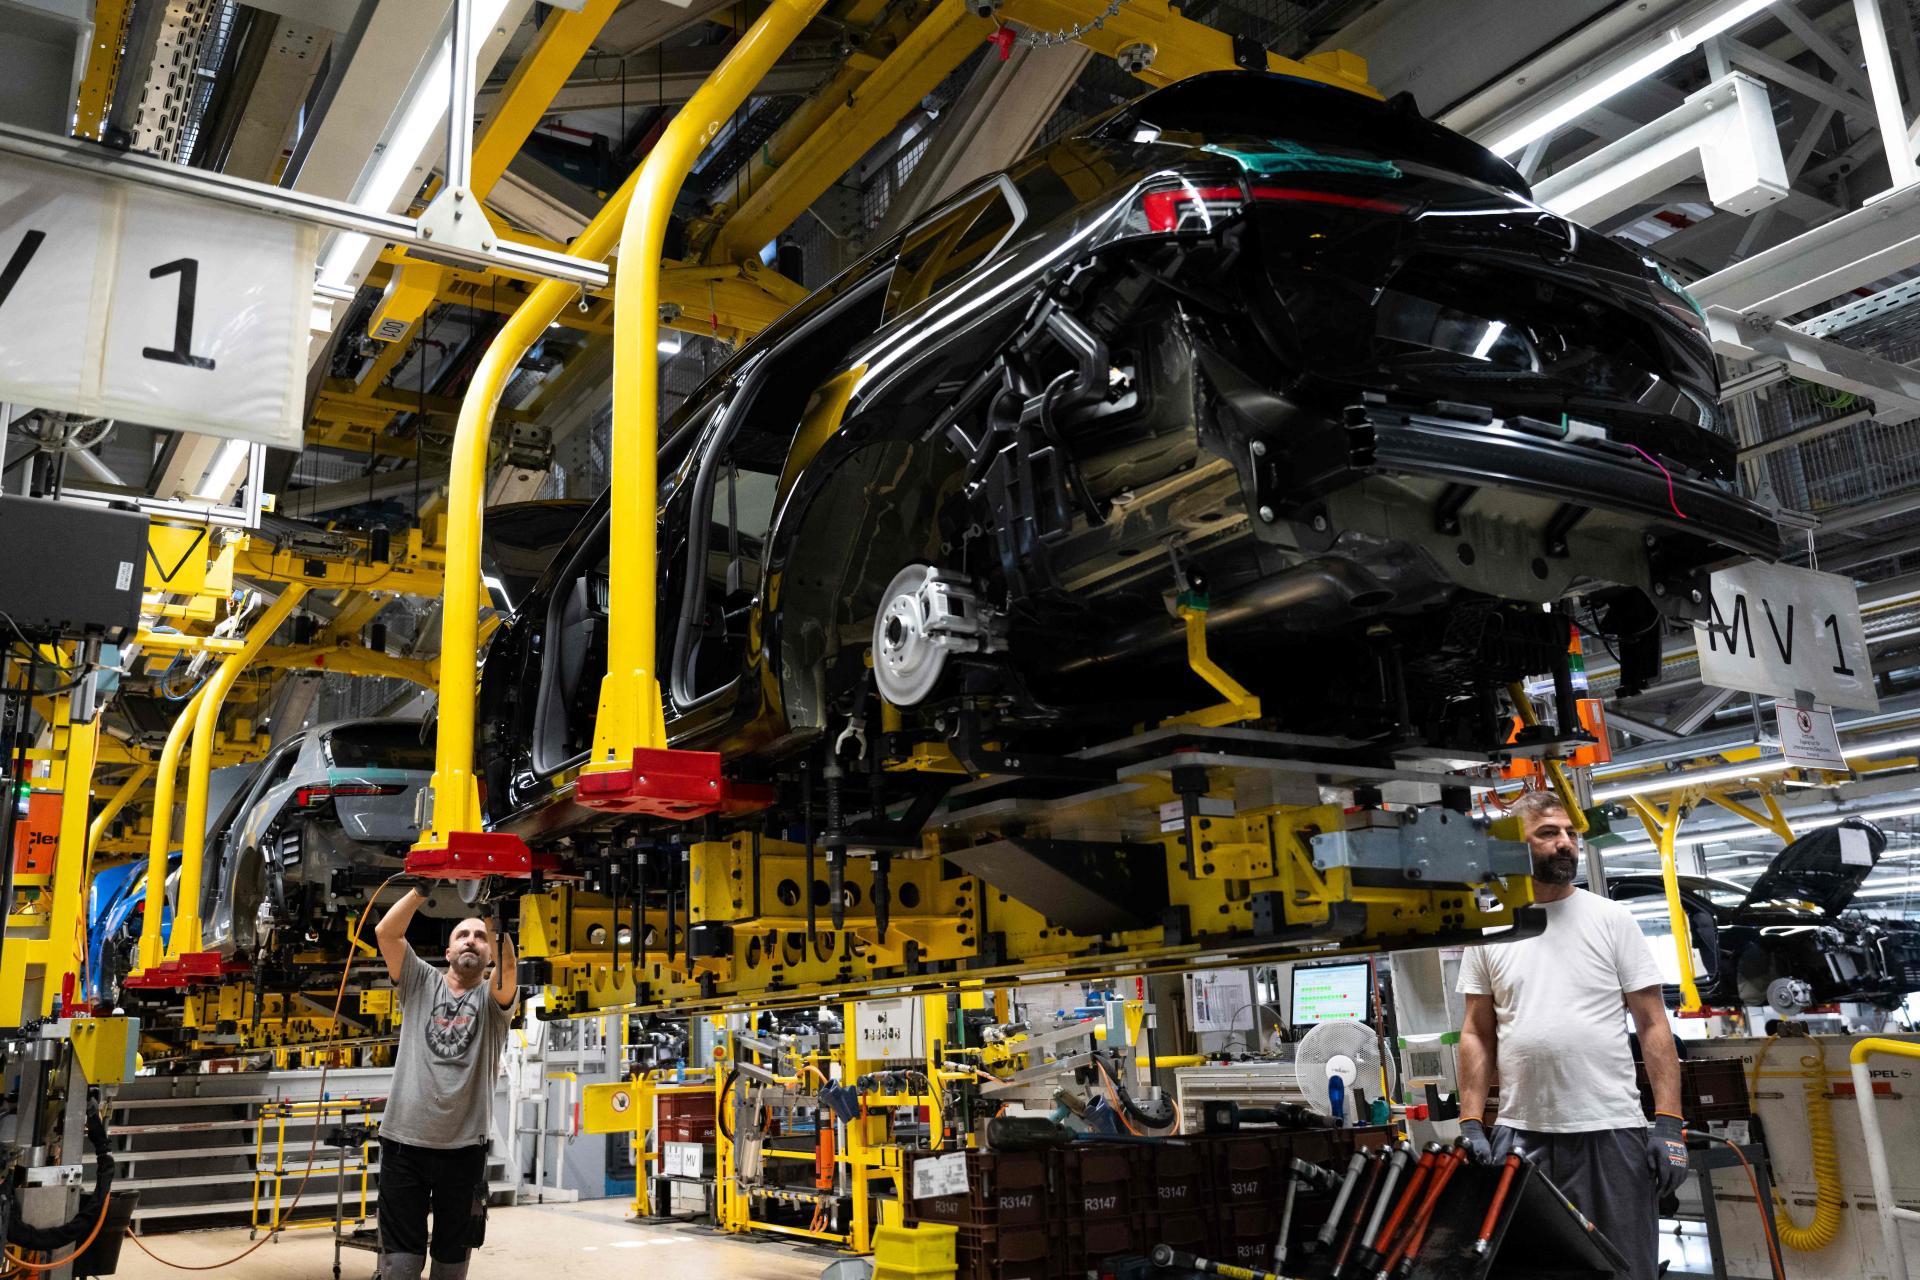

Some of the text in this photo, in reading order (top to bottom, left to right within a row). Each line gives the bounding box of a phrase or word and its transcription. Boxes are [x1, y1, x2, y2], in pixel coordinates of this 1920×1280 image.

[142, 257, 216, 371] 1
[1824, 614, 1855, 677] 1
[1158, 1186, 1188, 1199] R3147
[935, 1200, 959, 1214] R3147
[1000, 1195, 1033, 1209] R3147
[1084, 1196, 1117, 1211] R3147
[1237, 1244, 1266, 1257] R3147
